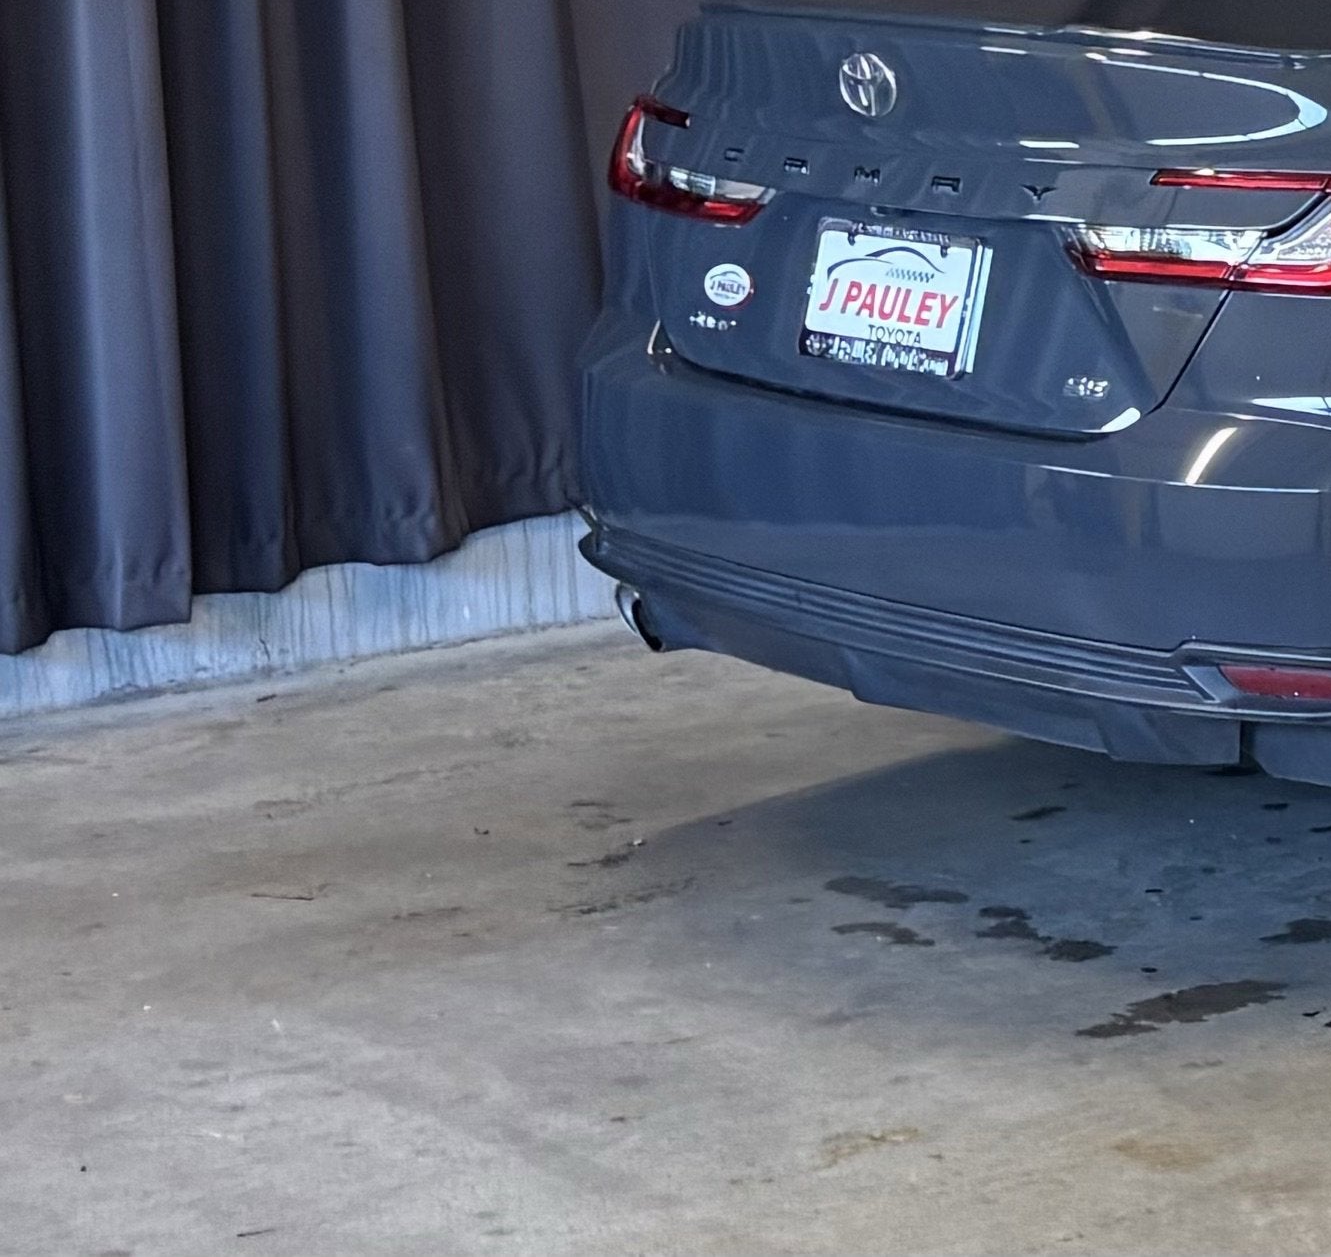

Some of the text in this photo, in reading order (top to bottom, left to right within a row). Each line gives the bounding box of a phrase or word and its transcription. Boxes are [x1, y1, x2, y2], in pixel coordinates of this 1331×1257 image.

[724, 147, 1056, 204] CAMRY
[819, 277, 958, 329] J PAULEY
[868, 324, 921, 345] TOYOTA
